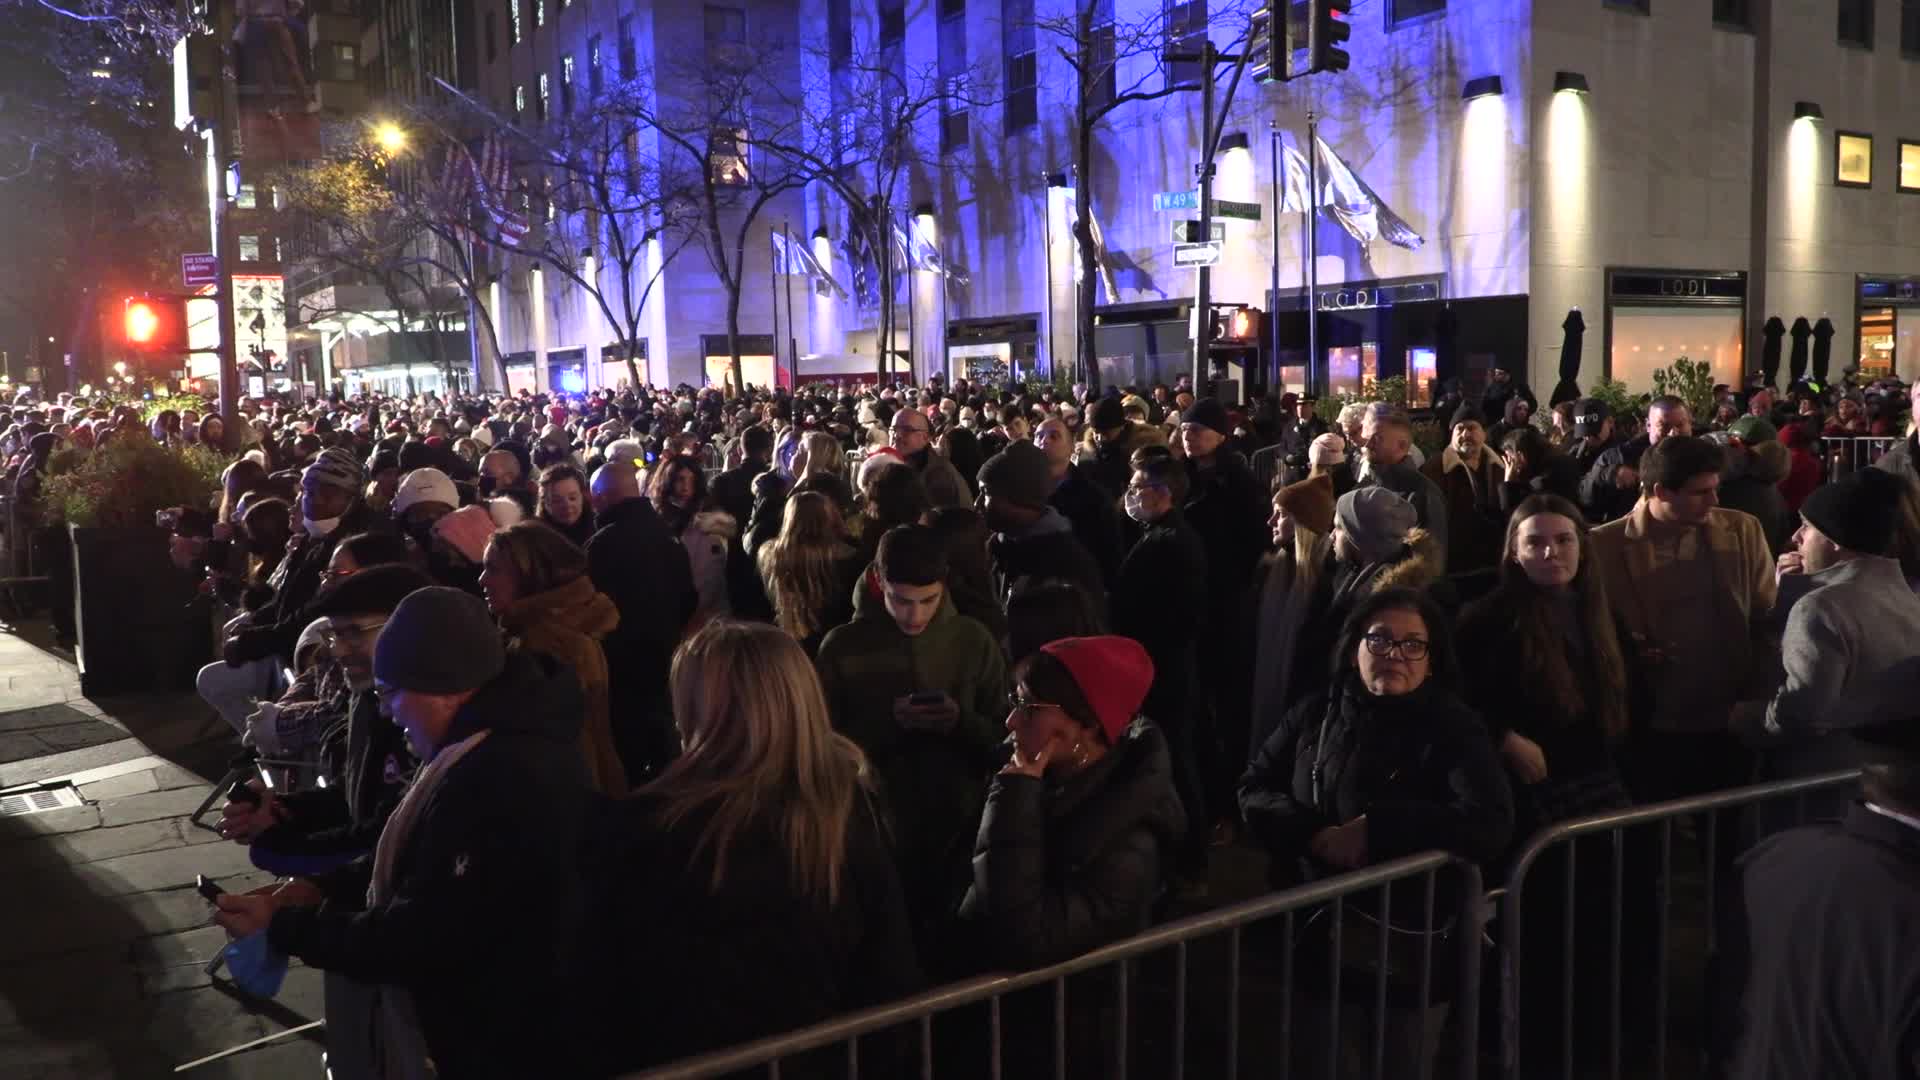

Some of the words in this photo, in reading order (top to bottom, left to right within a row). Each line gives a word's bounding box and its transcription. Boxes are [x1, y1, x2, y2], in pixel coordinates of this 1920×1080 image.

[1163, 195, 1171, 208] W
[1173, 193, 1186, 207] 49
[1661, 279, 1706, 296] LODI
[1575, 413, 1599, 424] NYPD
